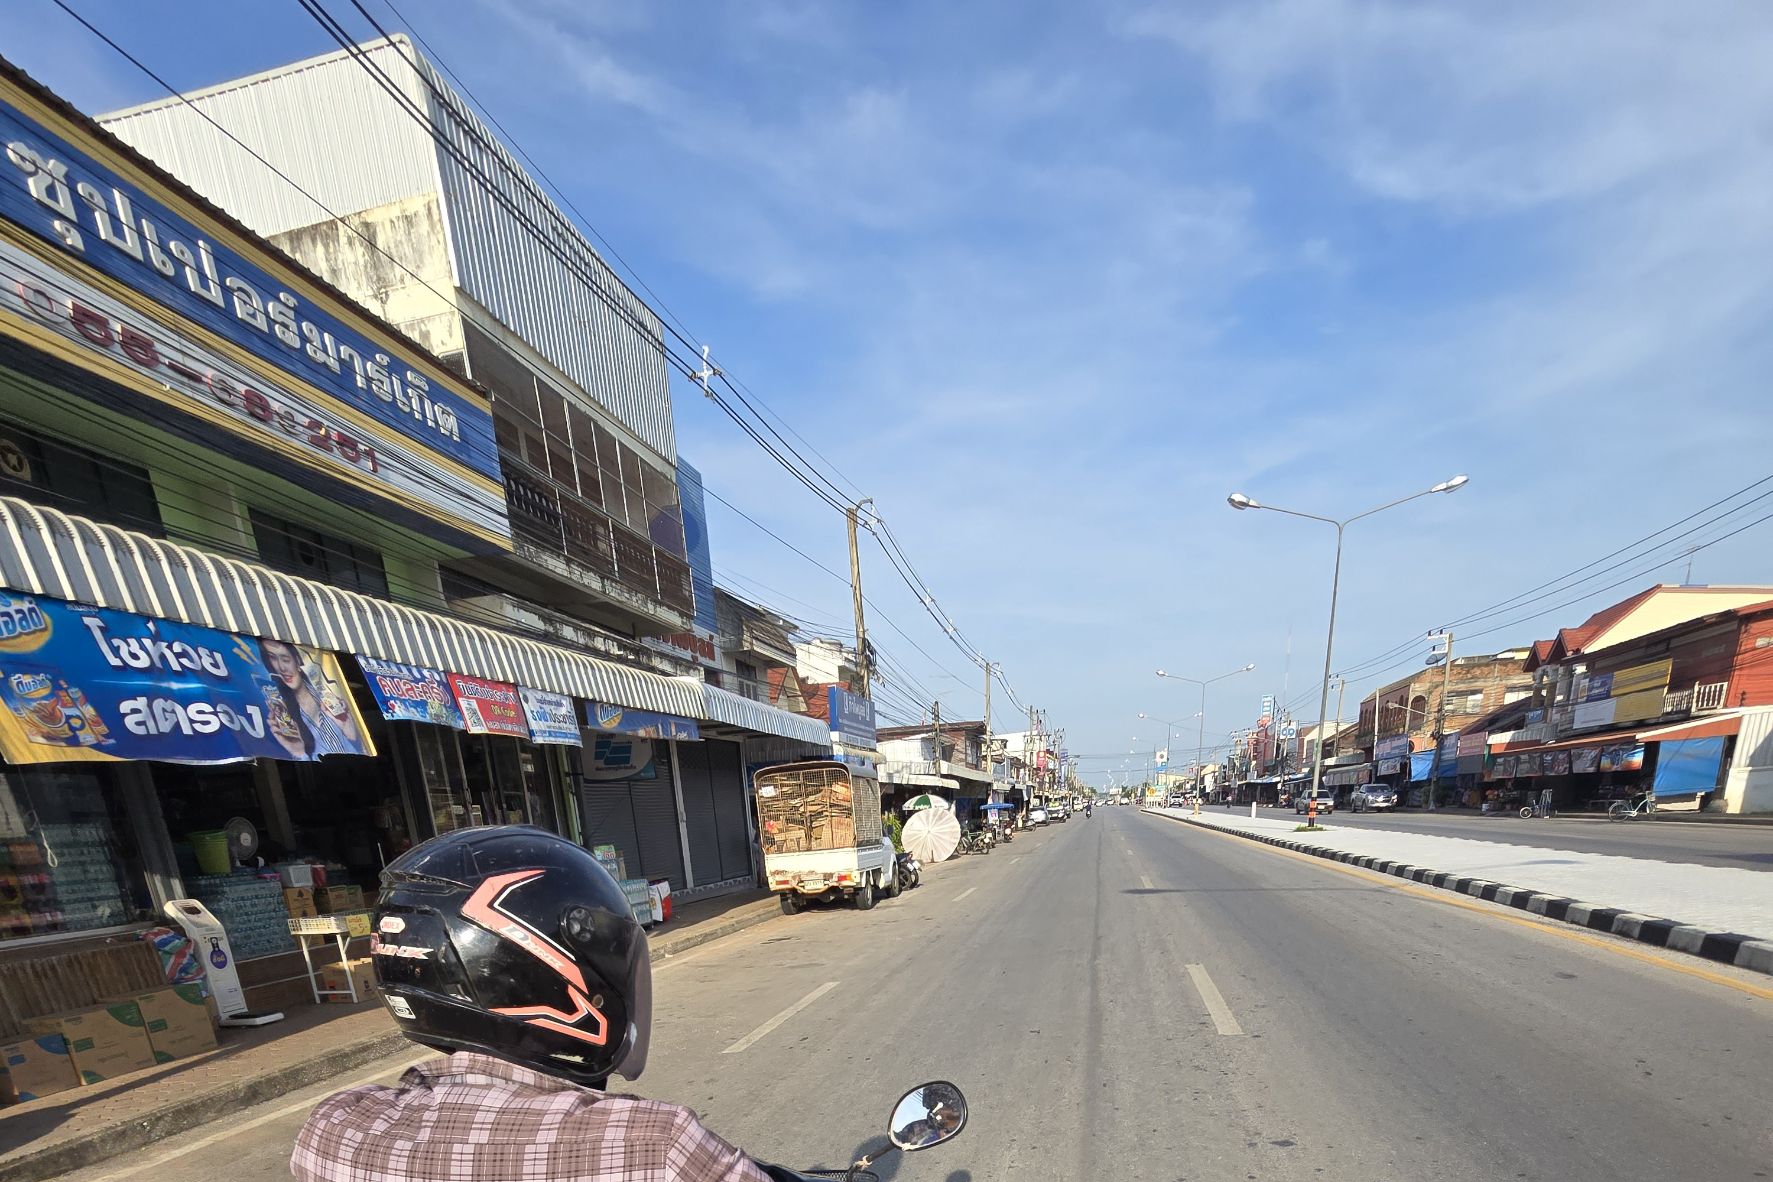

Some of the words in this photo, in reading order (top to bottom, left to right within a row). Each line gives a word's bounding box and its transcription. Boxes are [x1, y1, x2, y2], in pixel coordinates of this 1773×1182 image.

[83, 616, 230, 678] โชห่วย
[119, 697, 266, 740] สตรอง
